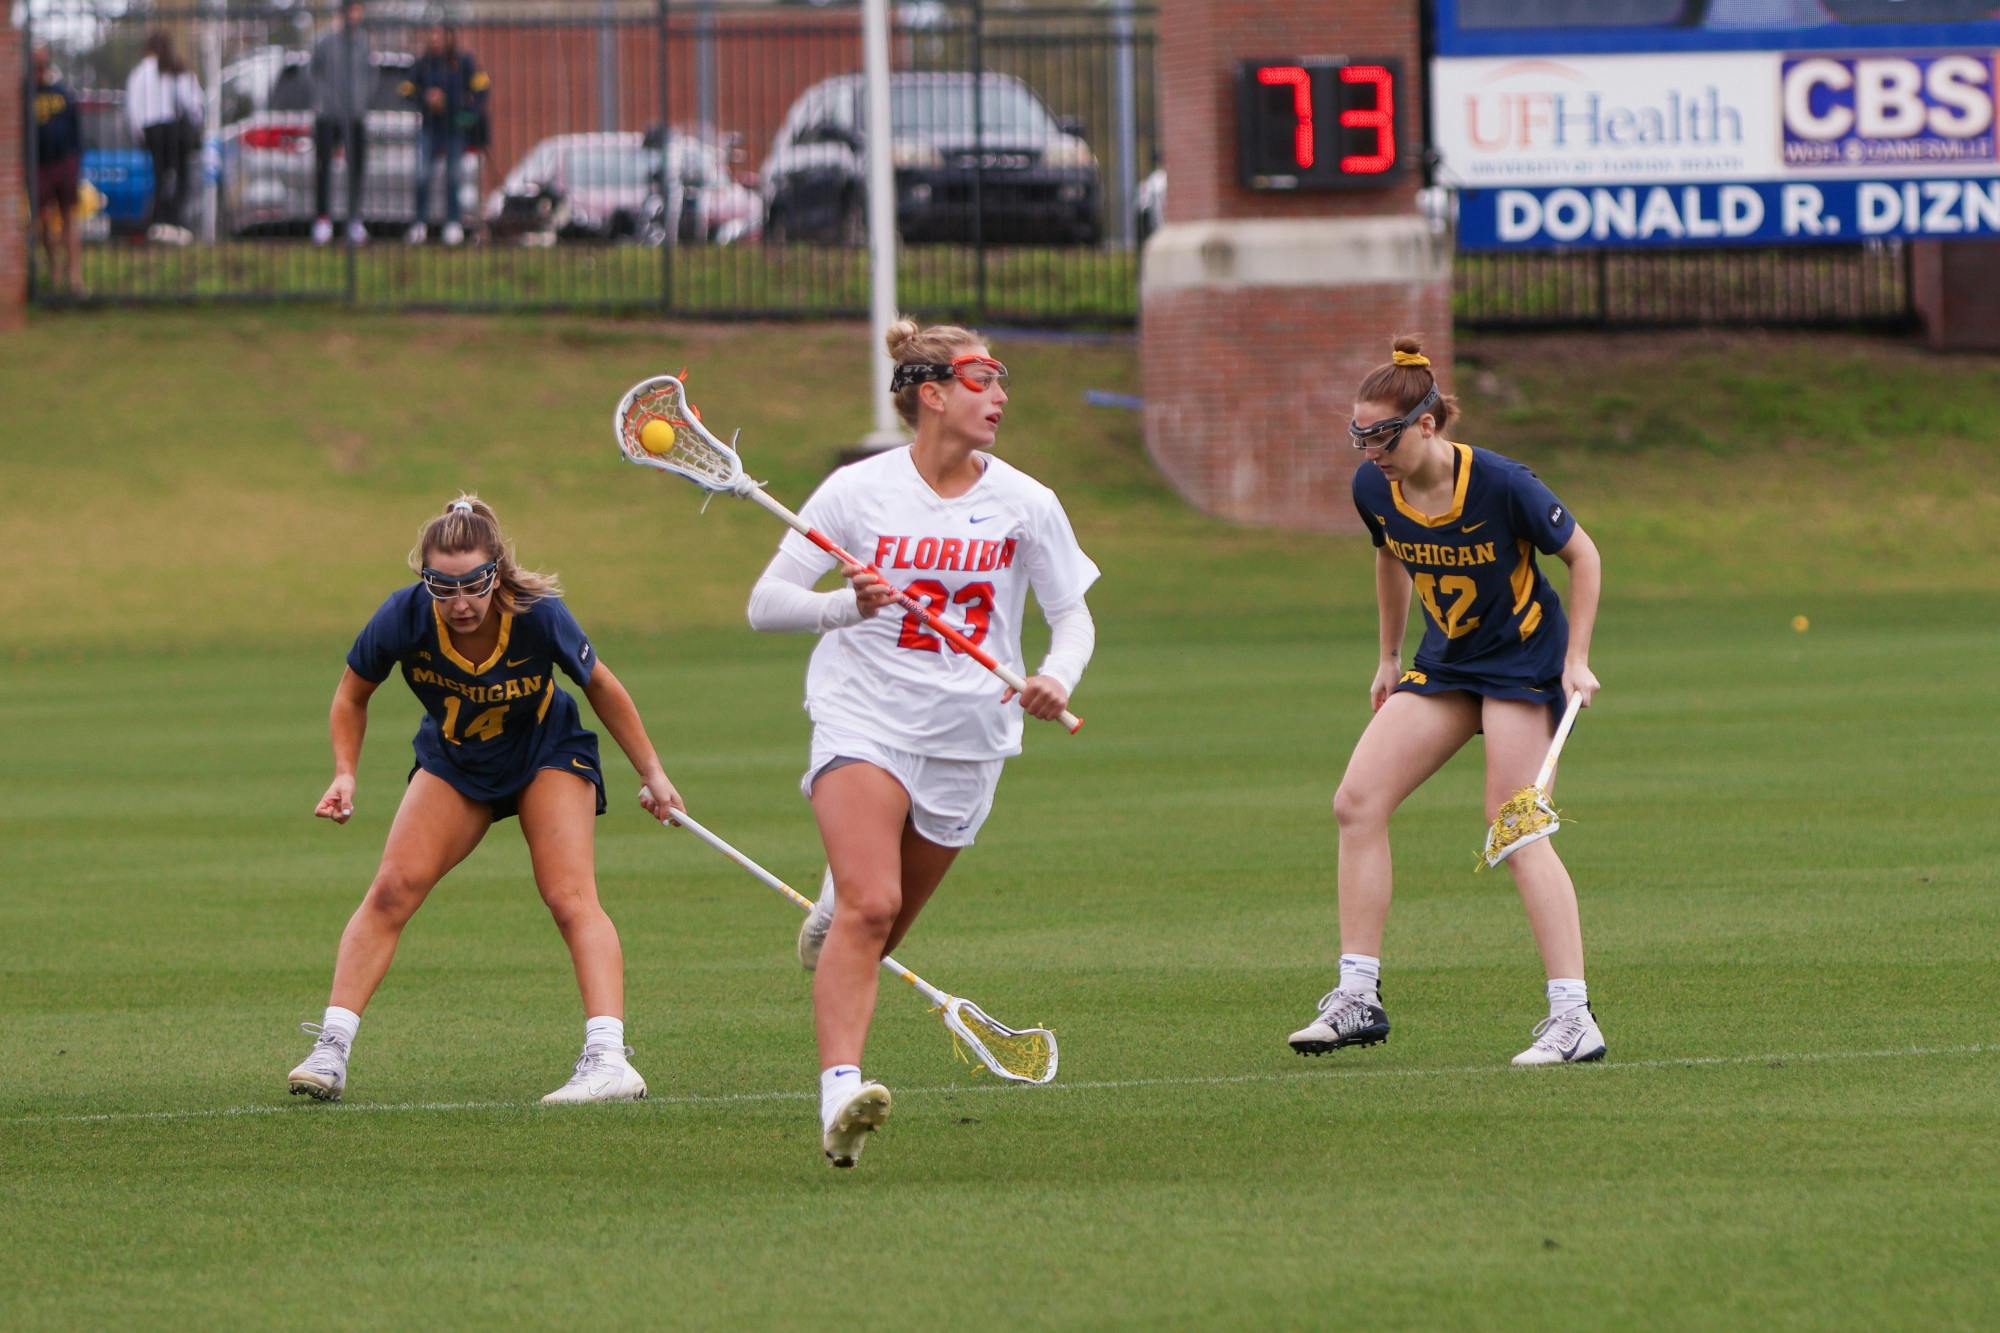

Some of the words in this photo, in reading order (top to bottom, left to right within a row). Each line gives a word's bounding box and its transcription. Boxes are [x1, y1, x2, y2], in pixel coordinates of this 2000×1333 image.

[1256, 64, 1396, 174] 73
[1783, 56, 1994, 141] CBS
[1497, 186, 1764, 241] DONALD
[1780, 185, 1840, 235] R.
[874, 535, 1018, 571] FLORIDA
[896, 578, 996, 655] 23
[412, 667, 542, 704] MICHIGAN
[442, 696, 510, 746] 14
